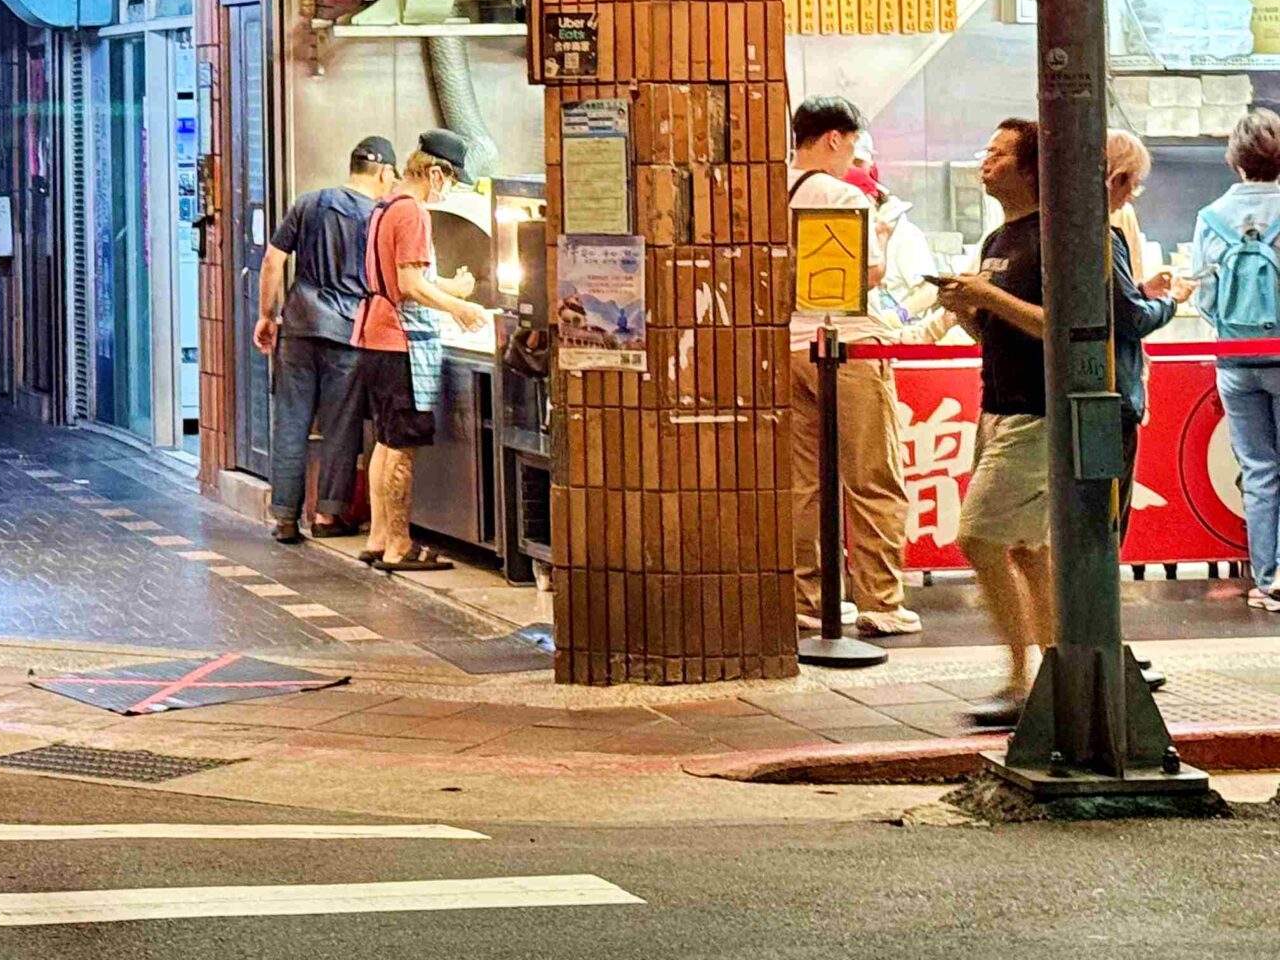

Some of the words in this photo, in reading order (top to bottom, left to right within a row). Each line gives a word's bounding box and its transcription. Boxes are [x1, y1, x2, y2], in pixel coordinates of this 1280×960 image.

[558, 16, 586, 29] Uber
[558, 28, 586, 40] Eats
[802, 223, 856, 301] 入口
